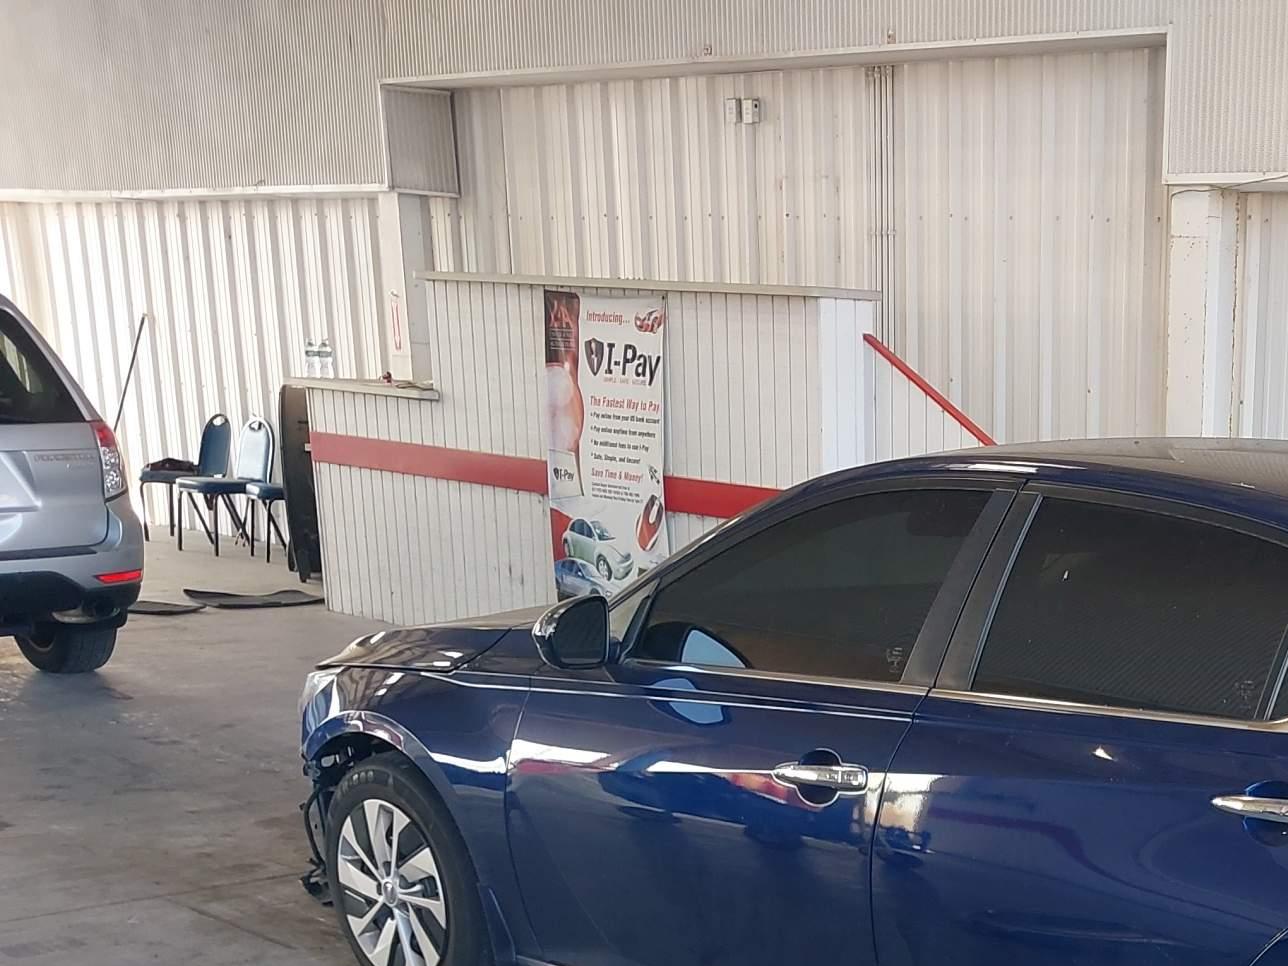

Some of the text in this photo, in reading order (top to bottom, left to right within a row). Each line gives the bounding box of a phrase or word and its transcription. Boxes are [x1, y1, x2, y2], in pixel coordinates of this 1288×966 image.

[586, 310, 630, 326] Introducing...
[604, 342, 661, 386] I-Pay
[590, 395, 660, 415] The Fastest Way to Pay
[559, 468, 575, 482] I-Pay
[591, 467, 604, 479] Save
[604, 469, 617, 480] Time
